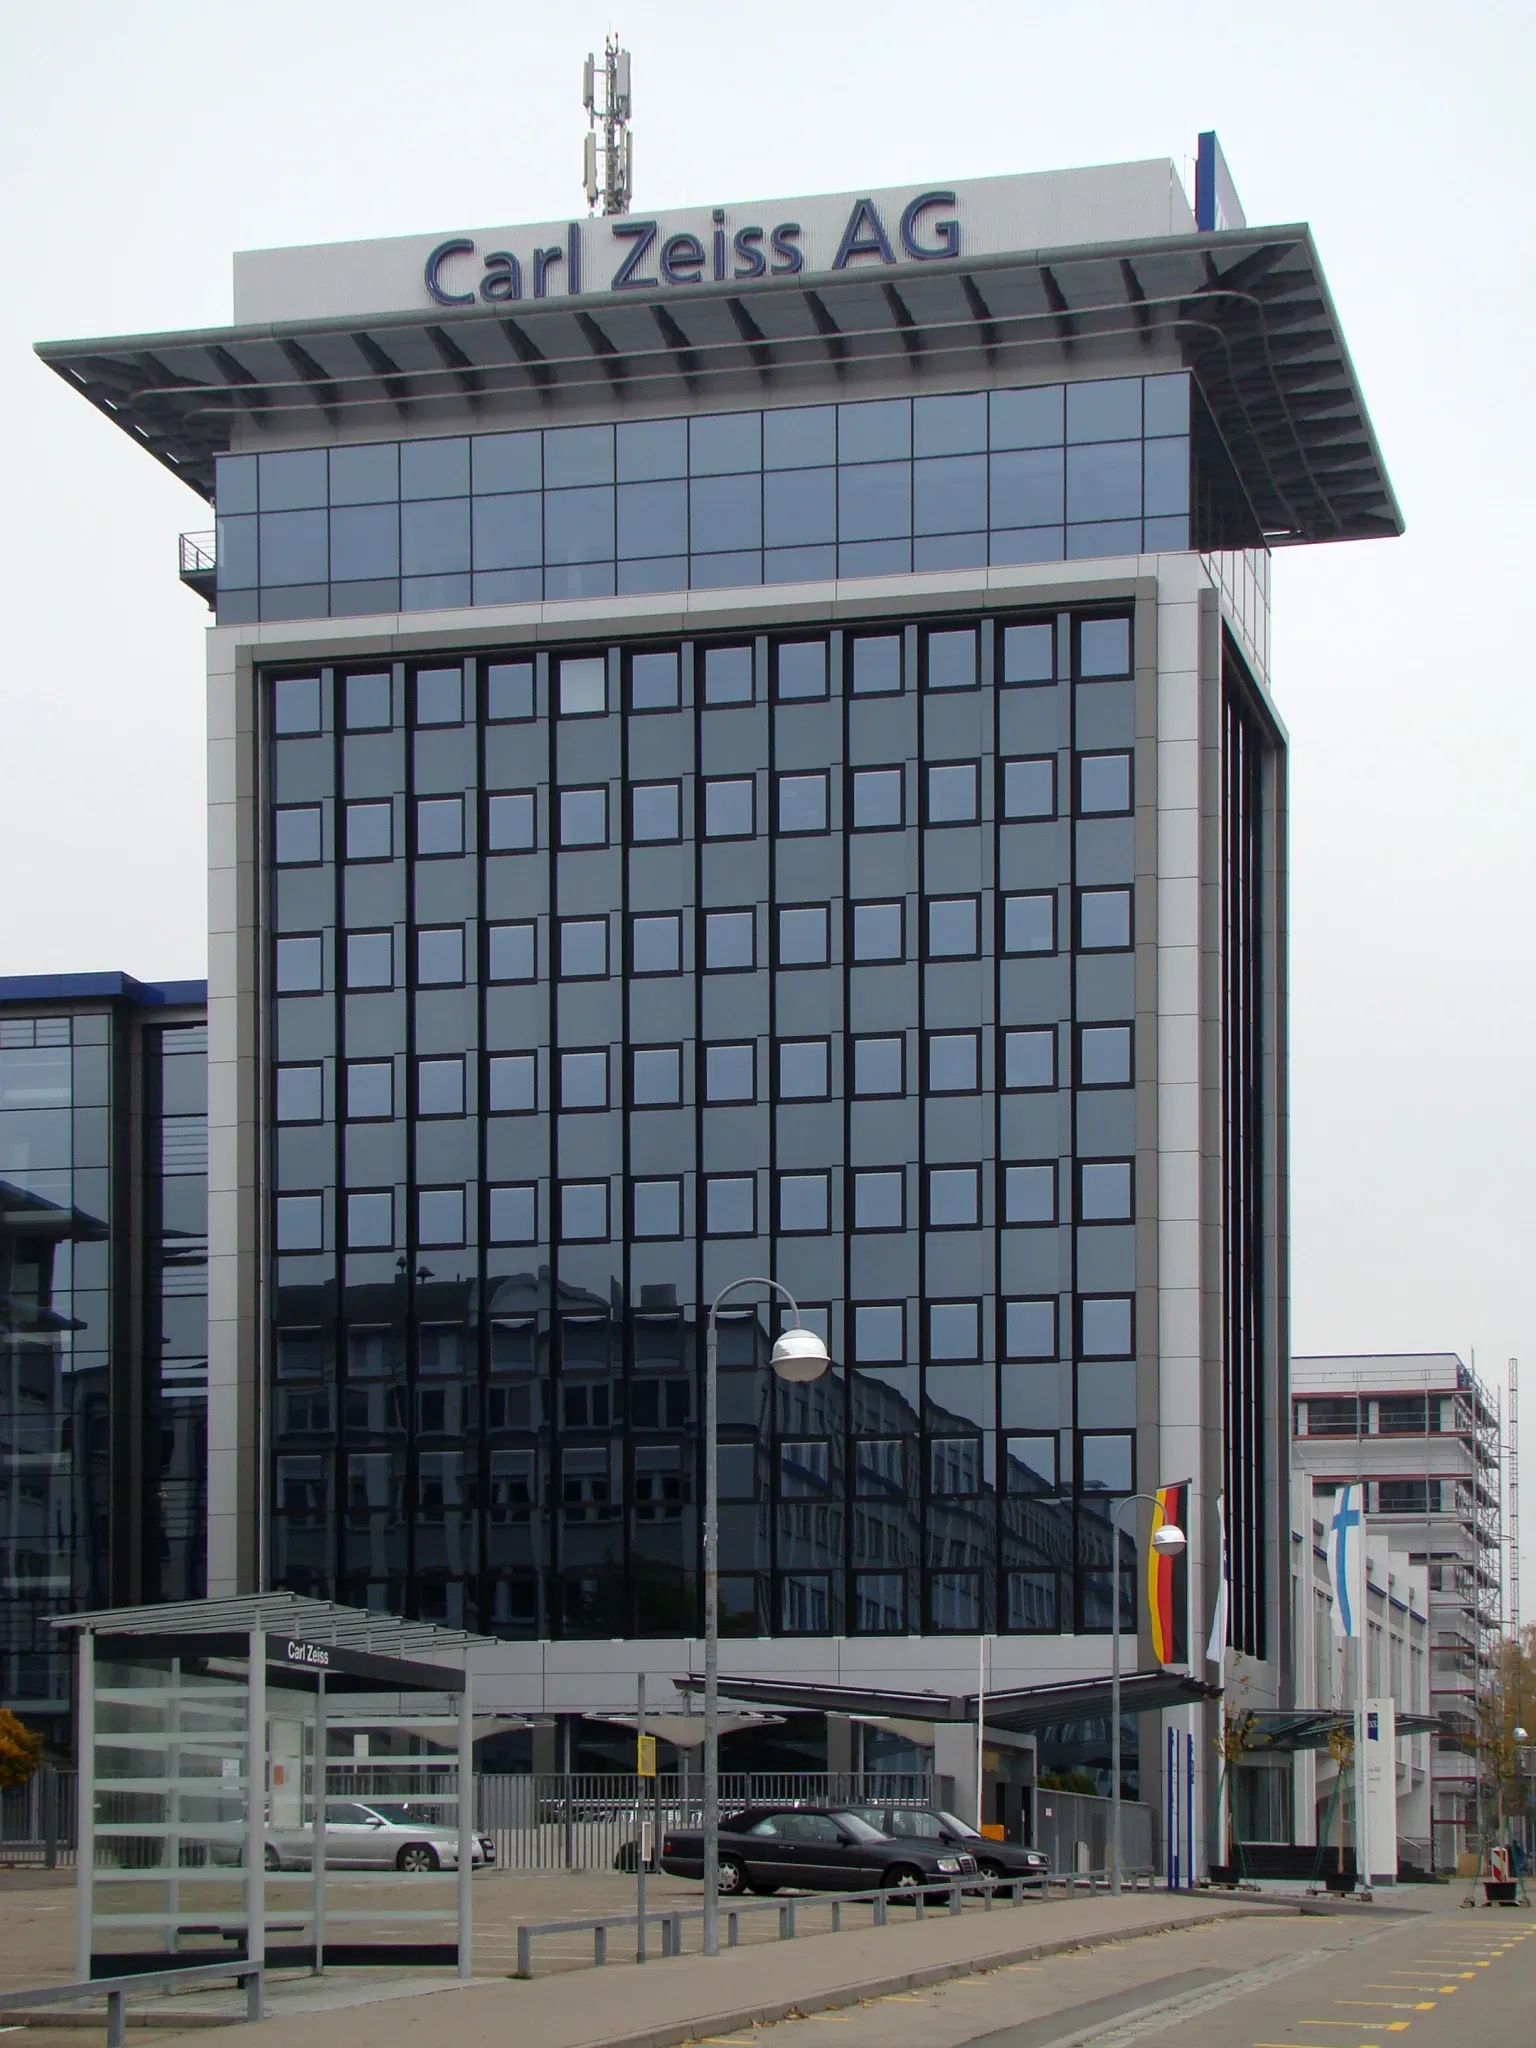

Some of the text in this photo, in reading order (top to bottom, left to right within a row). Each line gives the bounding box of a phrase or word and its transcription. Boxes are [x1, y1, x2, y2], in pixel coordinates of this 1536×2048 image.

[424, 191, 960, 305] Carl Zeiss AG
[288, 1641, 329, 1665] Carl Zeiss
